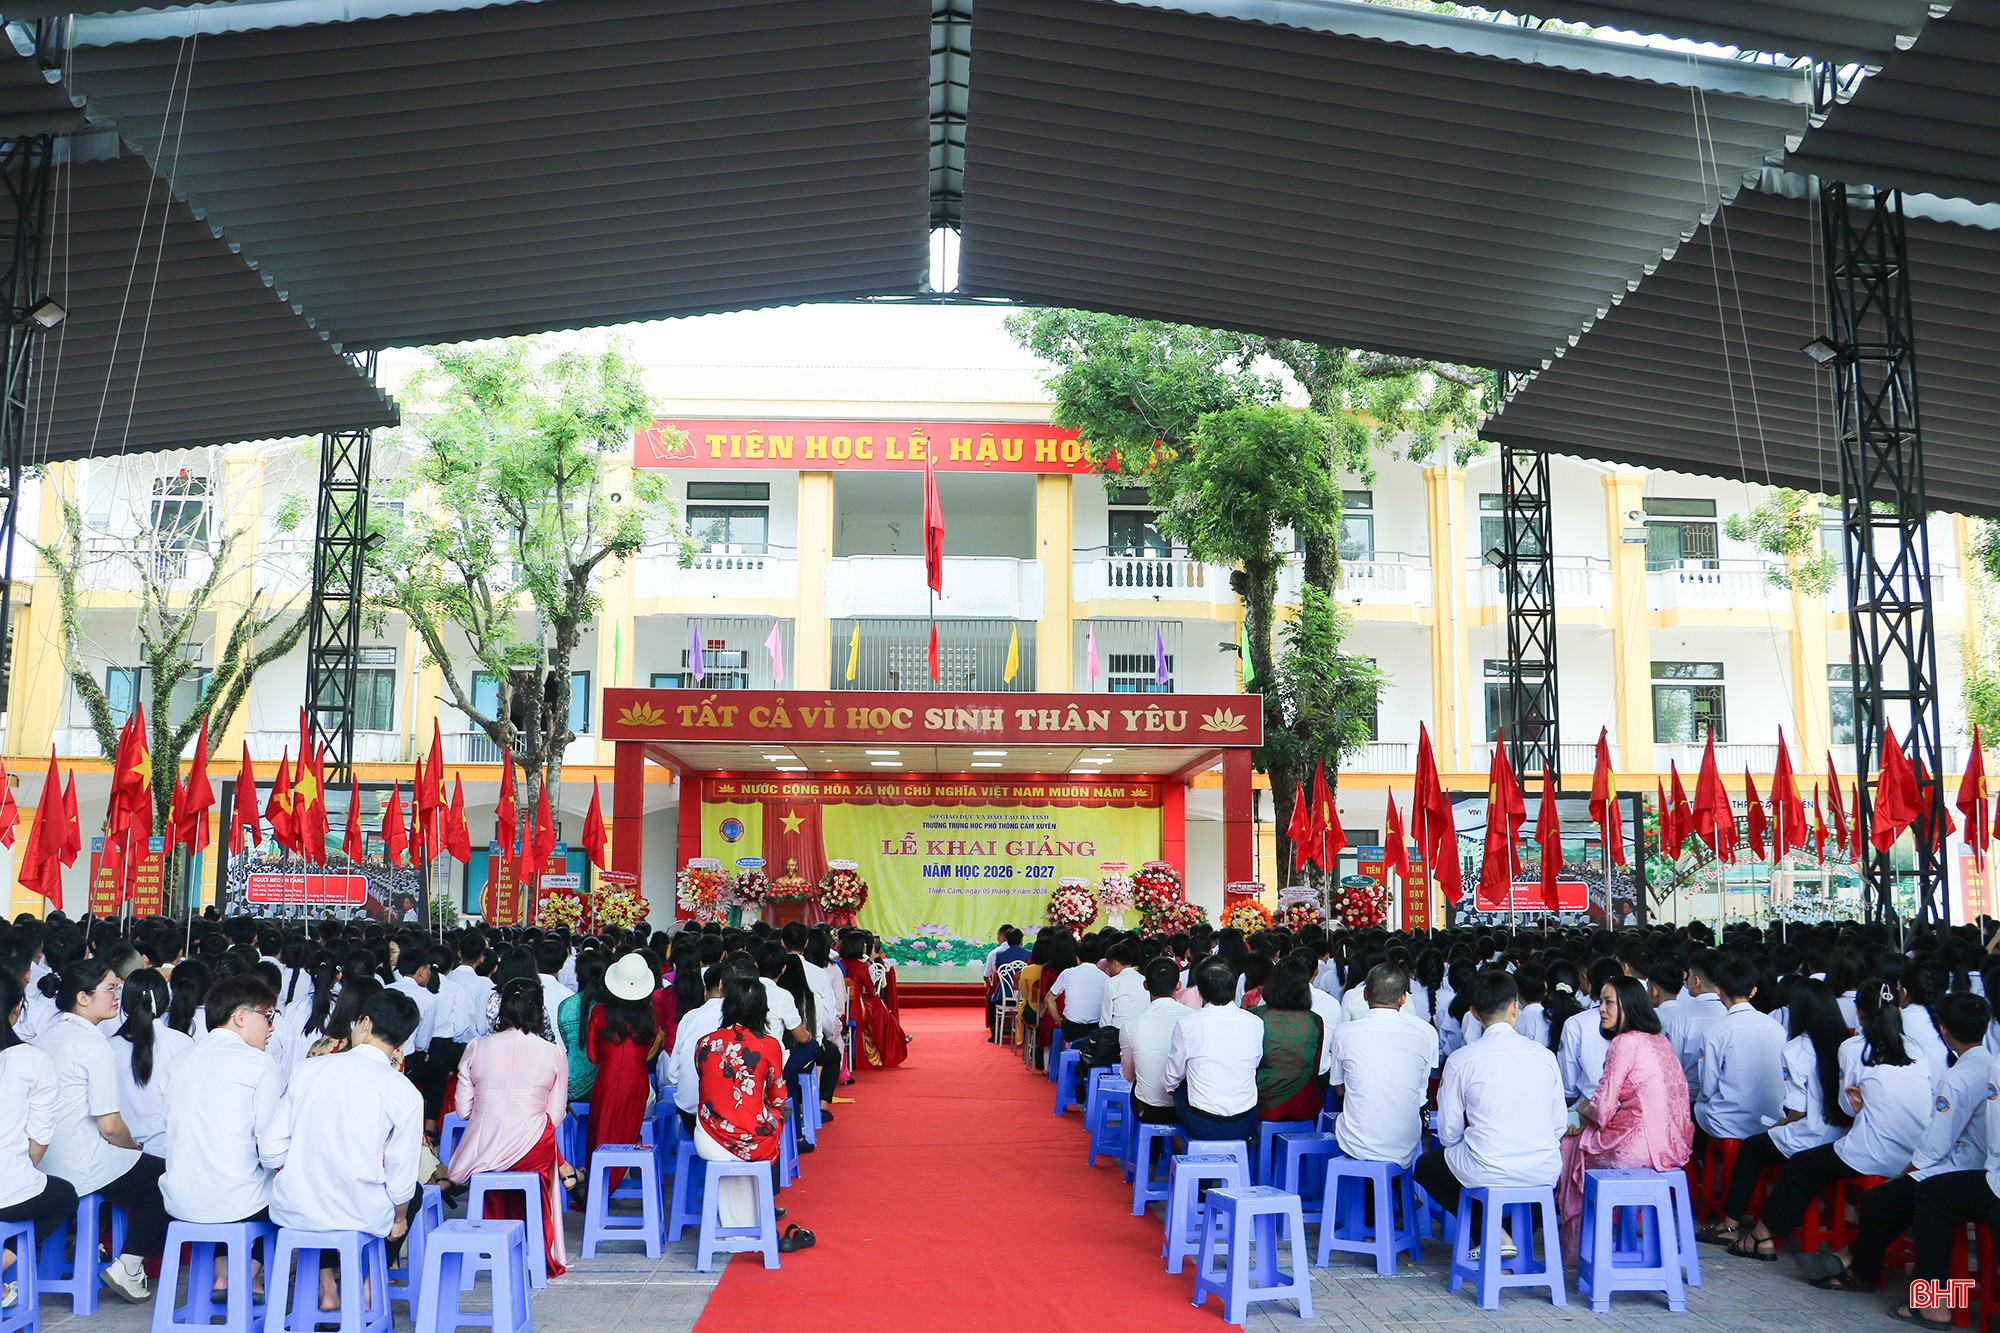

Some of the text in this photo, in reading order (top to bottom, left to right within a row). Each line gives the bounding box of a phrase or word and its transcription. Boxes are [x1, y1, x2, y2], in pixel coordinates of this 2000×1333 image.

[705, 429, 794, 459] TIÊN
[805, 435, 873, 465] HỌC
[950, 431, 1023, 466] HẬU
[677, 694, 1188, 735] TẤT CẢ VÌ HỌC SINH THÂN YÊU
[741, 783, 778, 794] NƯỚC
[782, 783, 819, 796] CỘNG
[855, 783, 873, 795] XÃ
[877, 784, 900, 797] HỘI
[904, 783, 931, 796] CHỦ
[935, 784, 977, 796] NGHĨA
[981, 785, 1008, 798] VIỆT
[1013, 787, 1045, 797] NAM
[1049, 785, 1090, 797] MUÔN
[1093, 785, 1125, 797] NĂM
[970, 822, 982, 830] HỌC
[881, 832, 1096, 857] LỄ KHAI GIẢNG
[922, 862, 951, 878] NĂM
[955, 865, 980, 880] HỌC
[983, 865, 1013, 878] 2026
[1025, 865, 1055, 878] 2027
